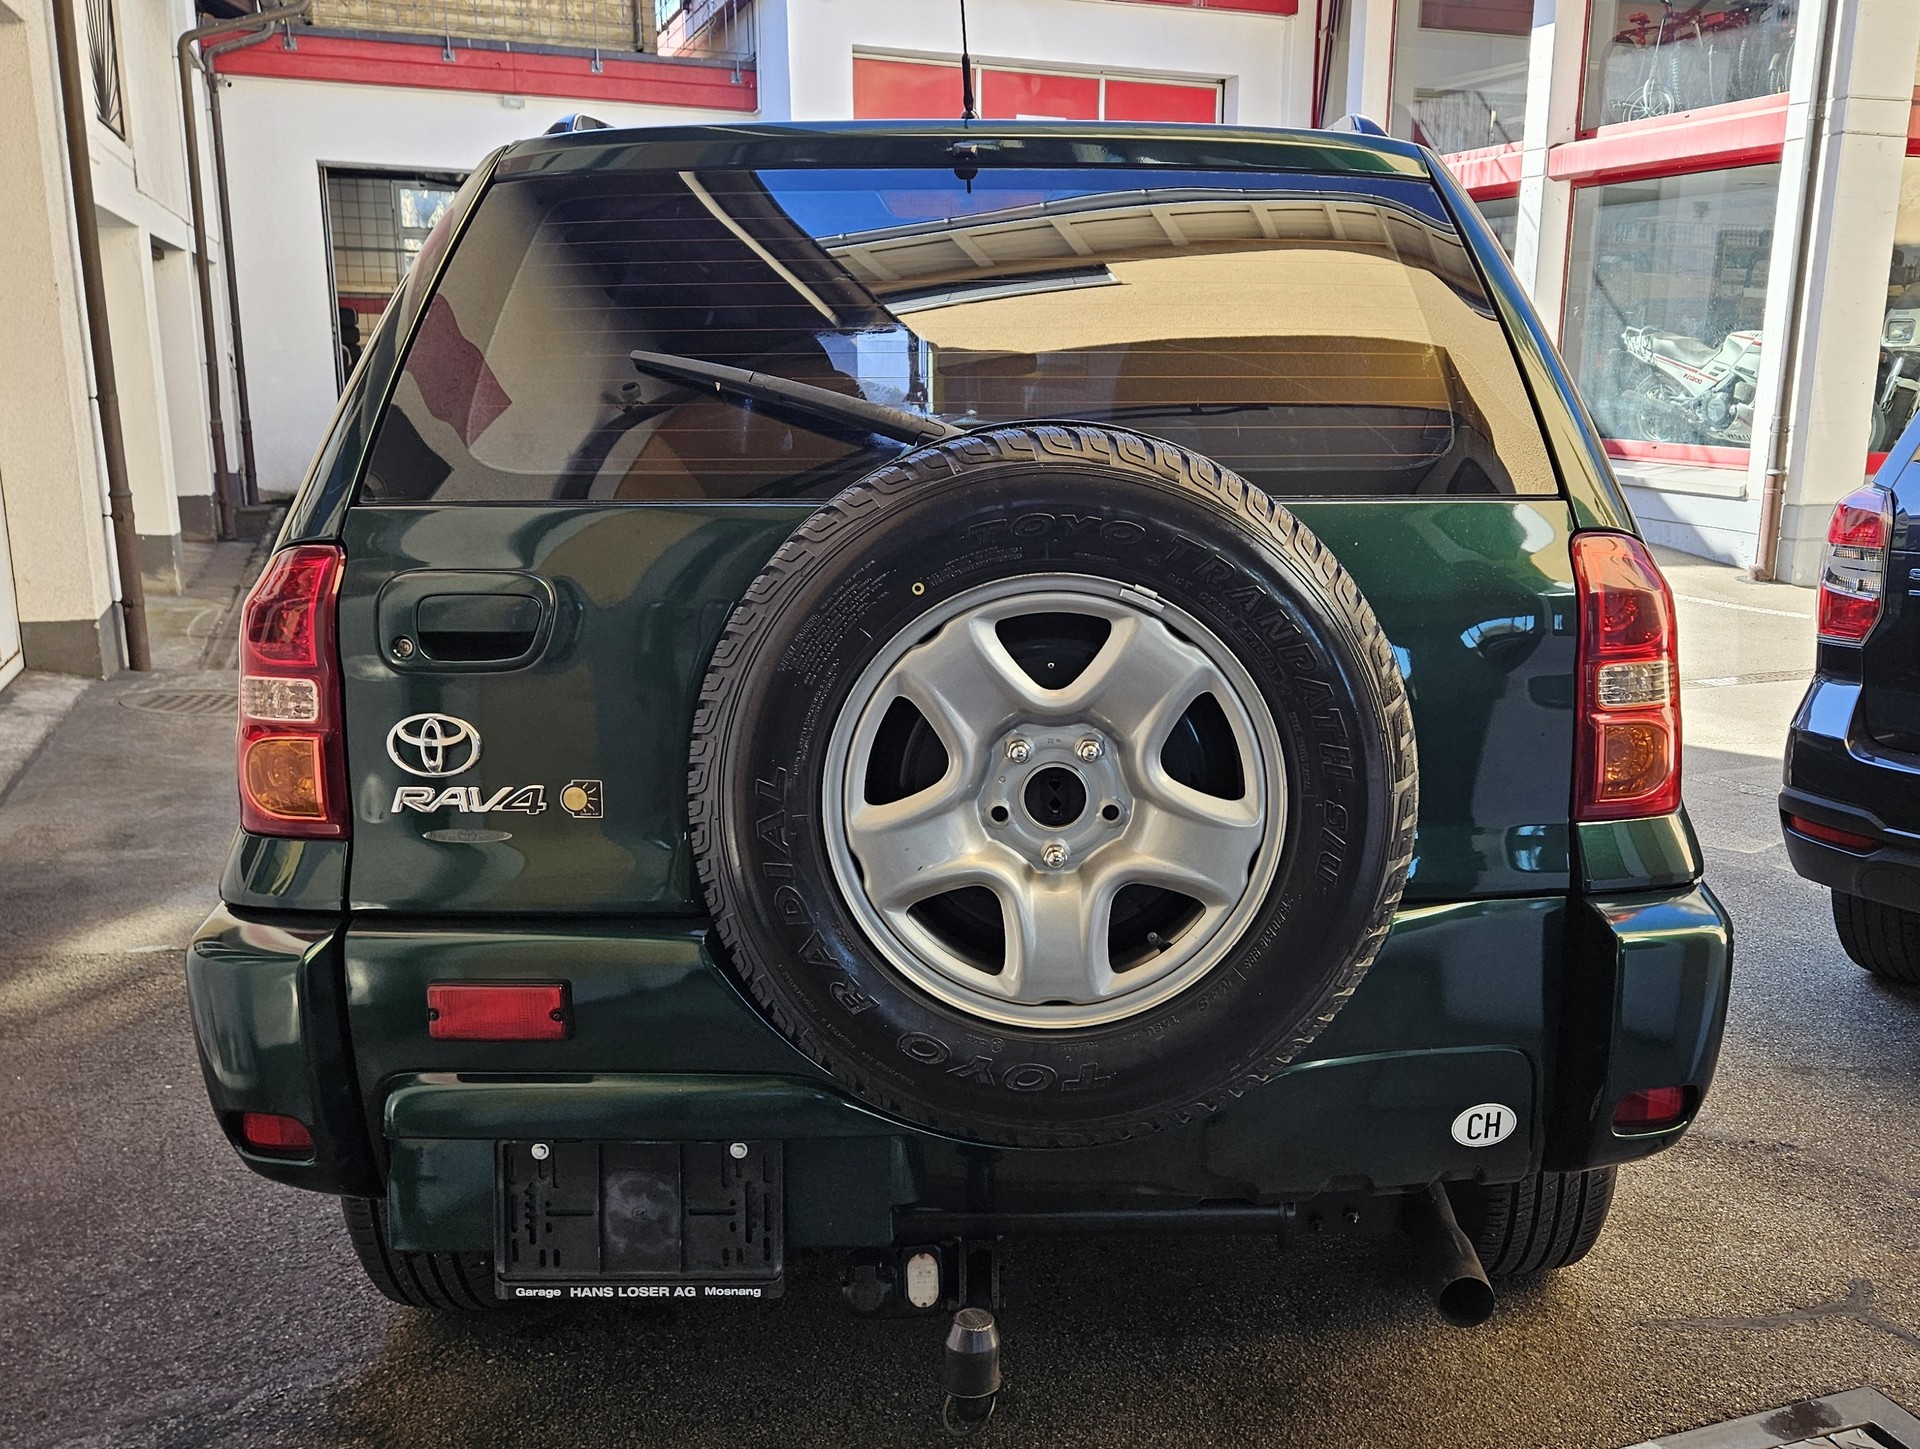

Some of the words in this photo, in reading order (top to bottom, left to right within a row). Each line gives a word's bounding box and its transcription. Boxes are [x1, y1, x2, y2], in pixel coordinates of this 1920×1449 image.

[967, 512, 1147, 547] TOYO
[1165, 533, 1355, 783] TRANPATH
[391, 785, 548, 815] RAV4
[755, 766, 881, 1018] RADIAL
[897, 1032, 1112, 1092] TOYO
[1467, 1112, 1501, 1139] CH
[515, 1287, 561, 1298] Garage
[570, 1287, 614, 1297] HANS
[618, 1287, 670, 1297] LOSER
[673, 1287, 696, 1297] AG
[704, 1287, 762, 1298] Mosnang
